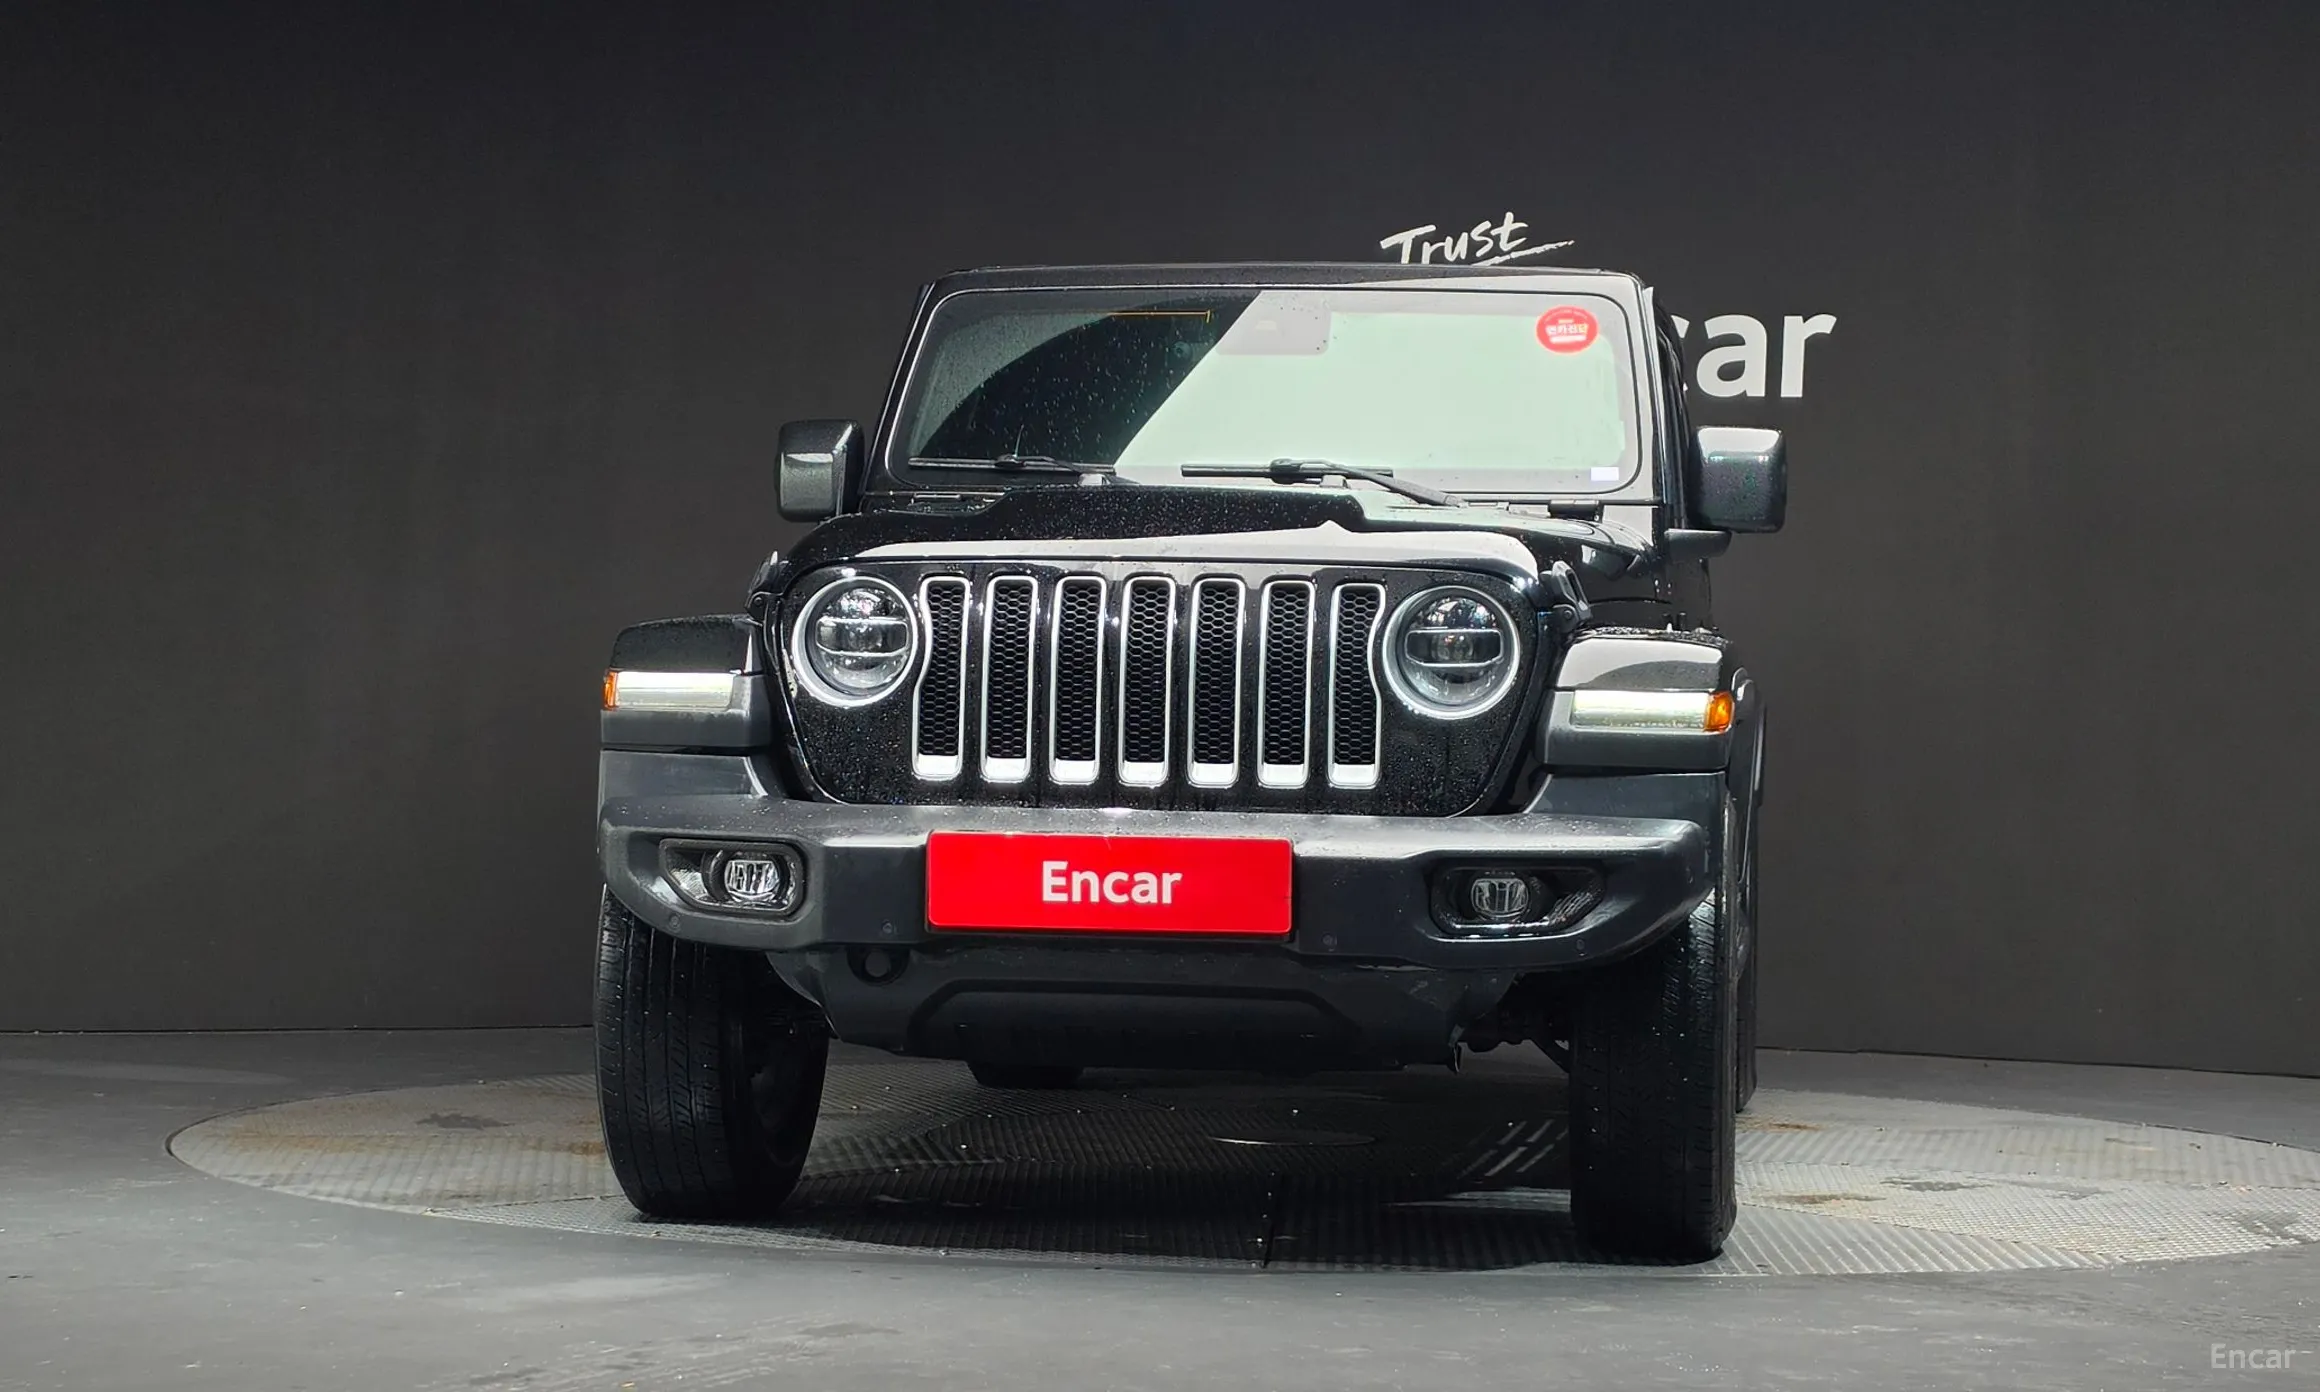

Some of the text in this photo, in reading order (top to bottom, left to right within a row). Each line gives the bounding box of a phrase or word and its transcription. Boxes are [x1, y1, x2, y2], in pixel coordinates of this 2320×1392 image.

[1380, 211, 1529, 265] Trust
[1671, 313, 1837, 398] ar
[1042, 860, 1183, 904] Encar
